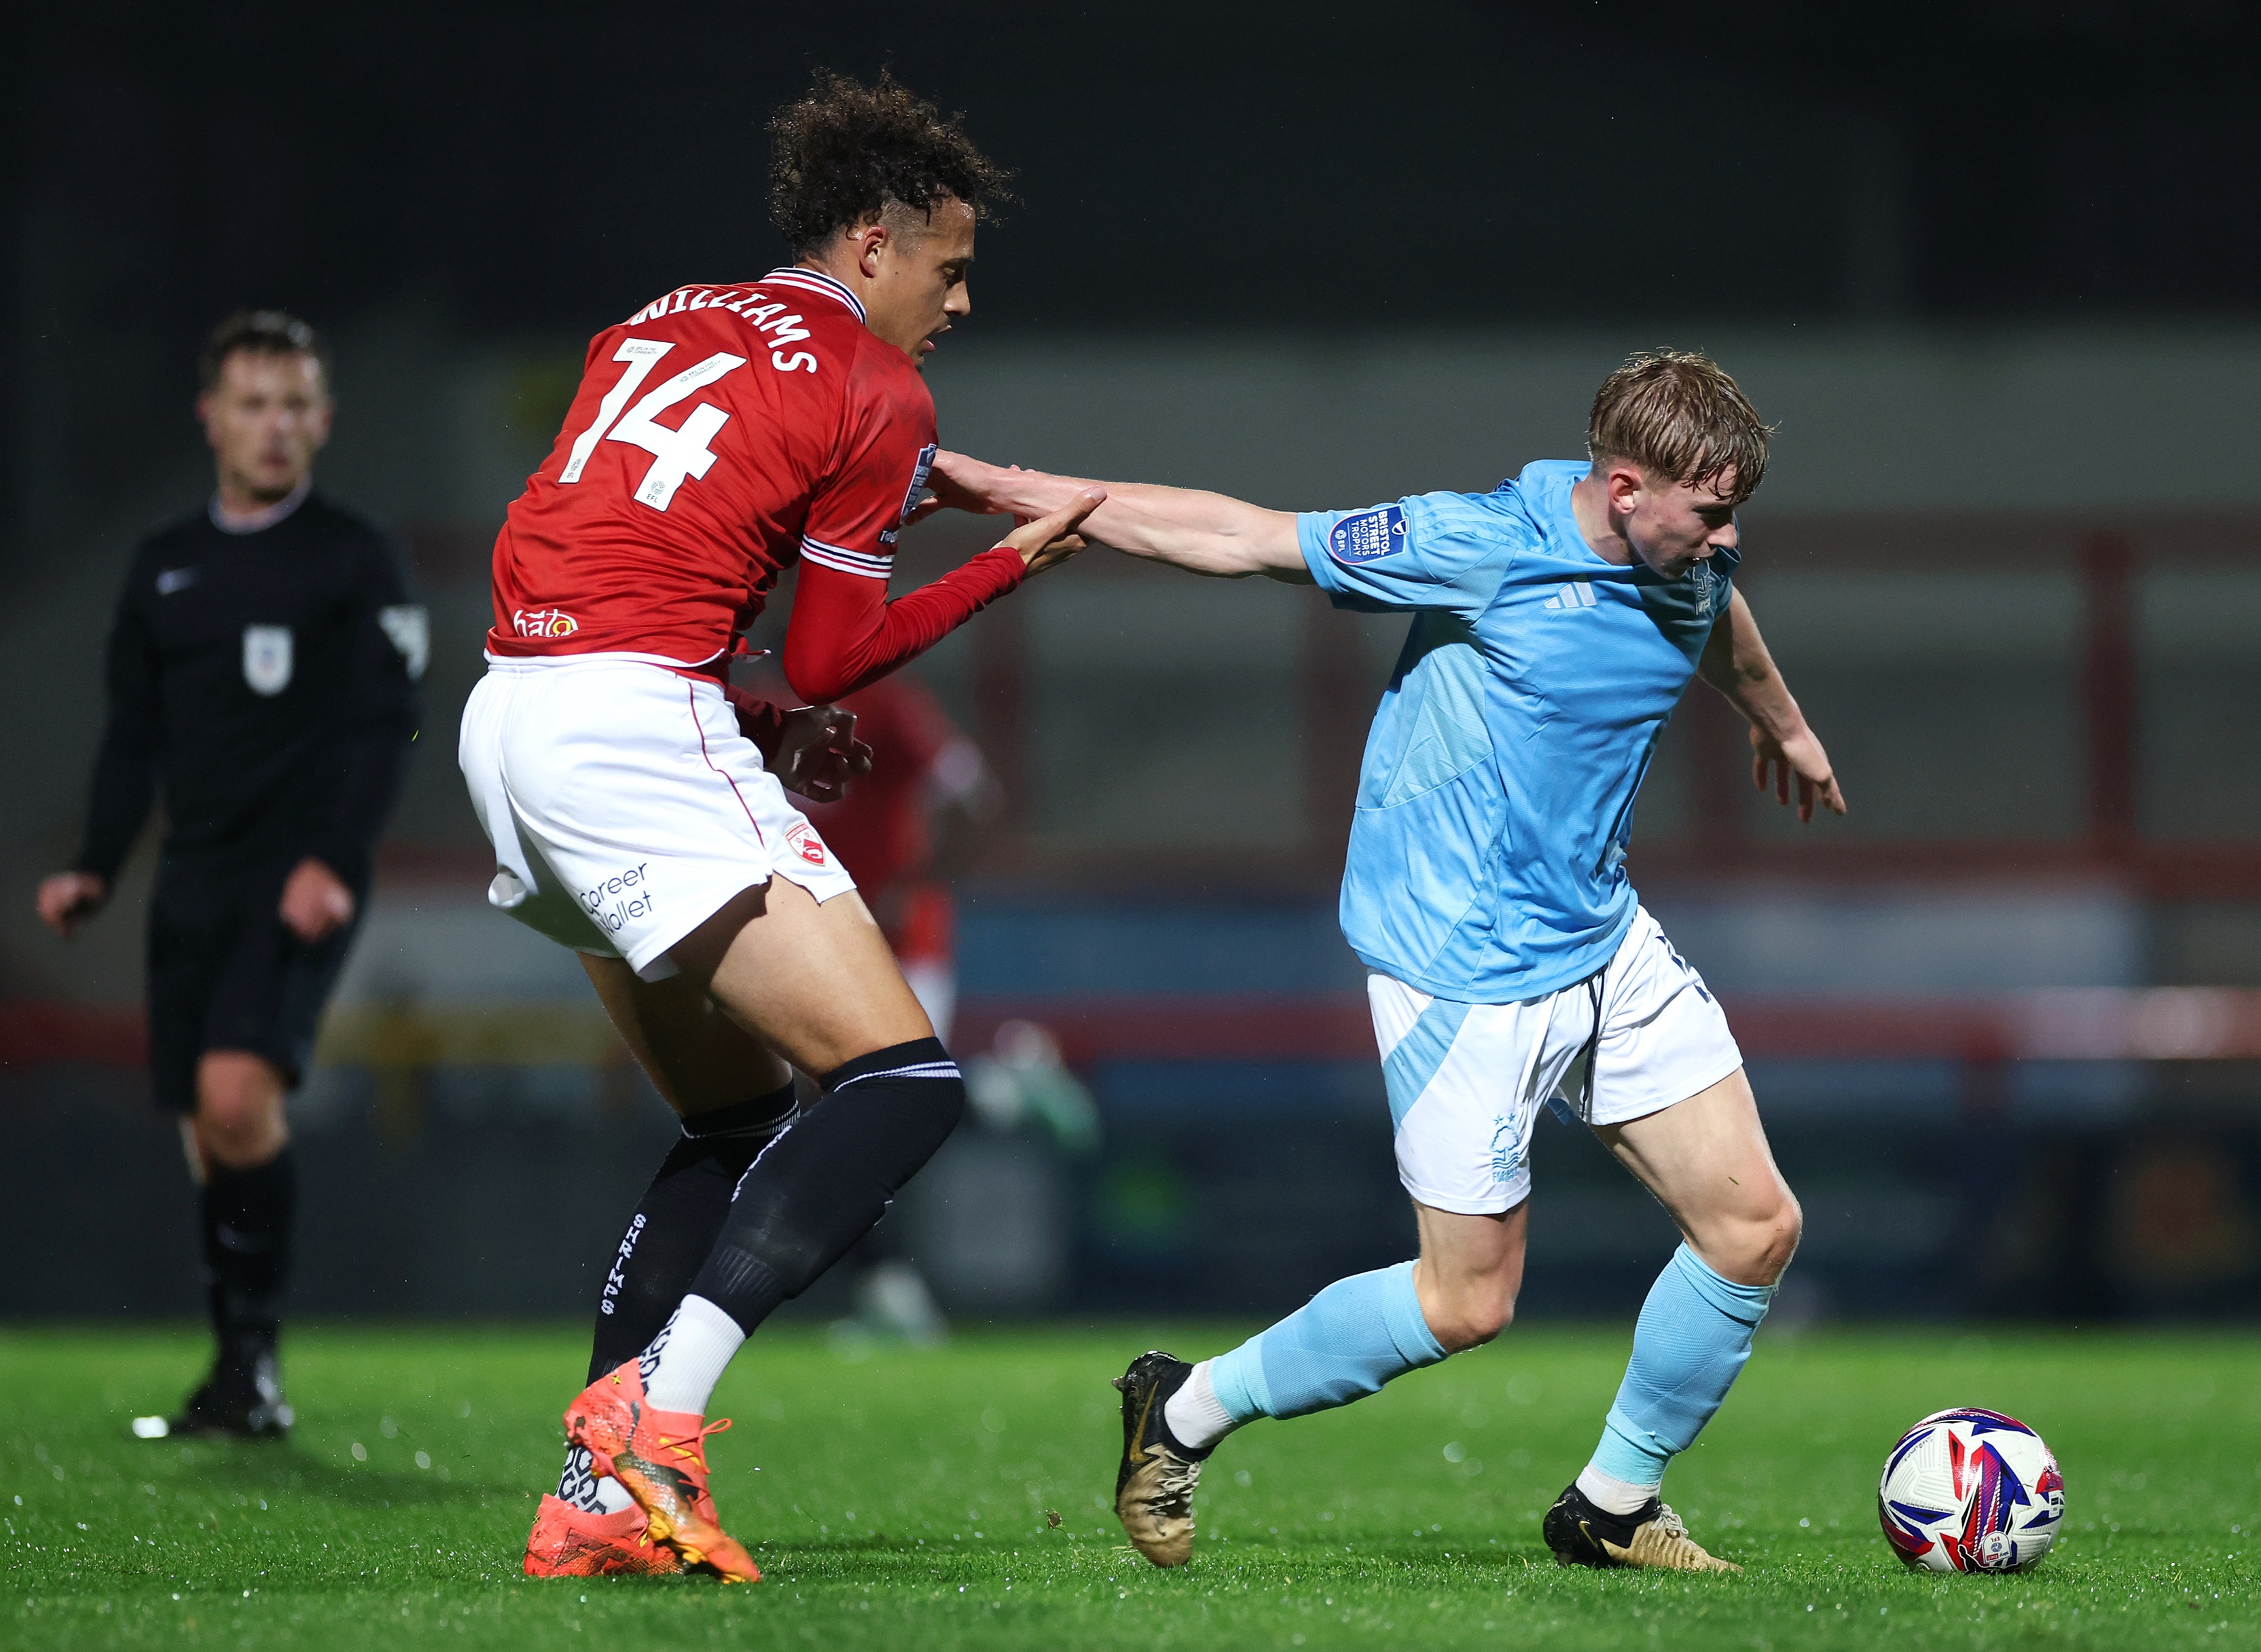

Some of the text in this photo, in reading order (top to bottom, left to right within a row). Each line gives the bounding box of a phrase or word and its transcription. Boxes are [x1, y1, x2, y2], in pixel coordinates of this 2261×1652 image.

[630, 289, 817, 373] WILLIAMS
[558, 337, 747, 512] 14
[646, 493, 657, 503] EFL
[1337, 540, 1345, 552] EFL
[1351, 521, 1361, 556] TROPHY
[1360, 519, 1370, 556] MOTORS
[1369, 515, 1380, 555] STREET
[1378, 511, 1390, 555] BRISTOL
[600, 1213, 647, 1315] SHRIMPS
